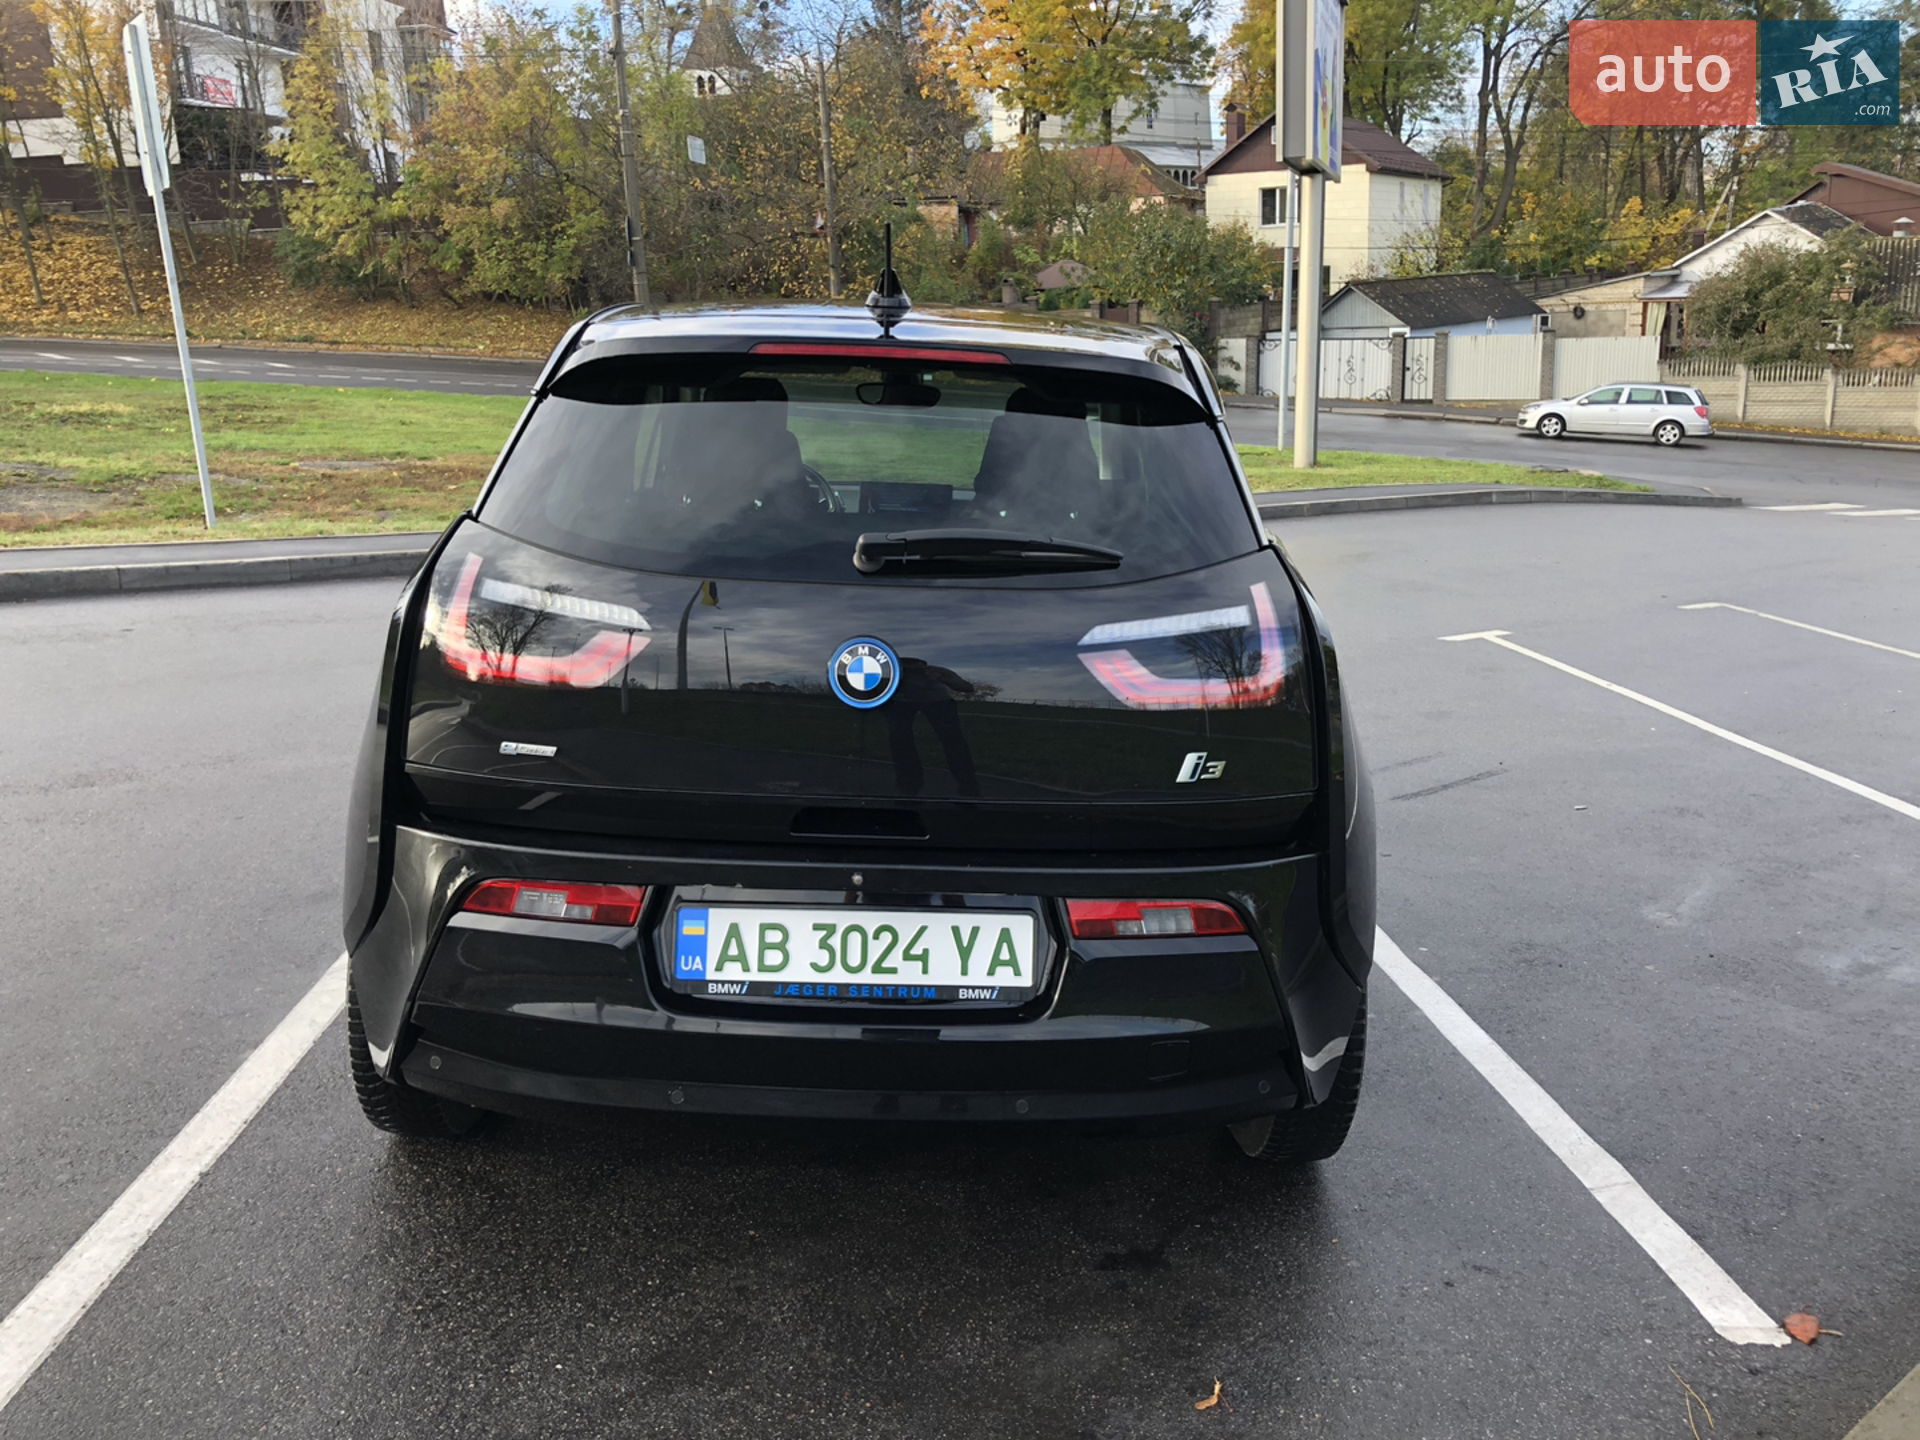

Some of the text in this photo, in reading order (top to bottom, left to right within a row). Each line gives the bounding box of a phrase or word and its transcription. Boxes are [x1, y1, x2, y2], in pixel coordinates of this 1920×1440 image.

[840, 646, 888, 665] BMW
[1176, 752, 1227, 783] i3
[714, 922, 1022, 977] AB 3024 YA
[680, 955, 704, 971] UA
[848, 985, 937, 999] SENTRUM
